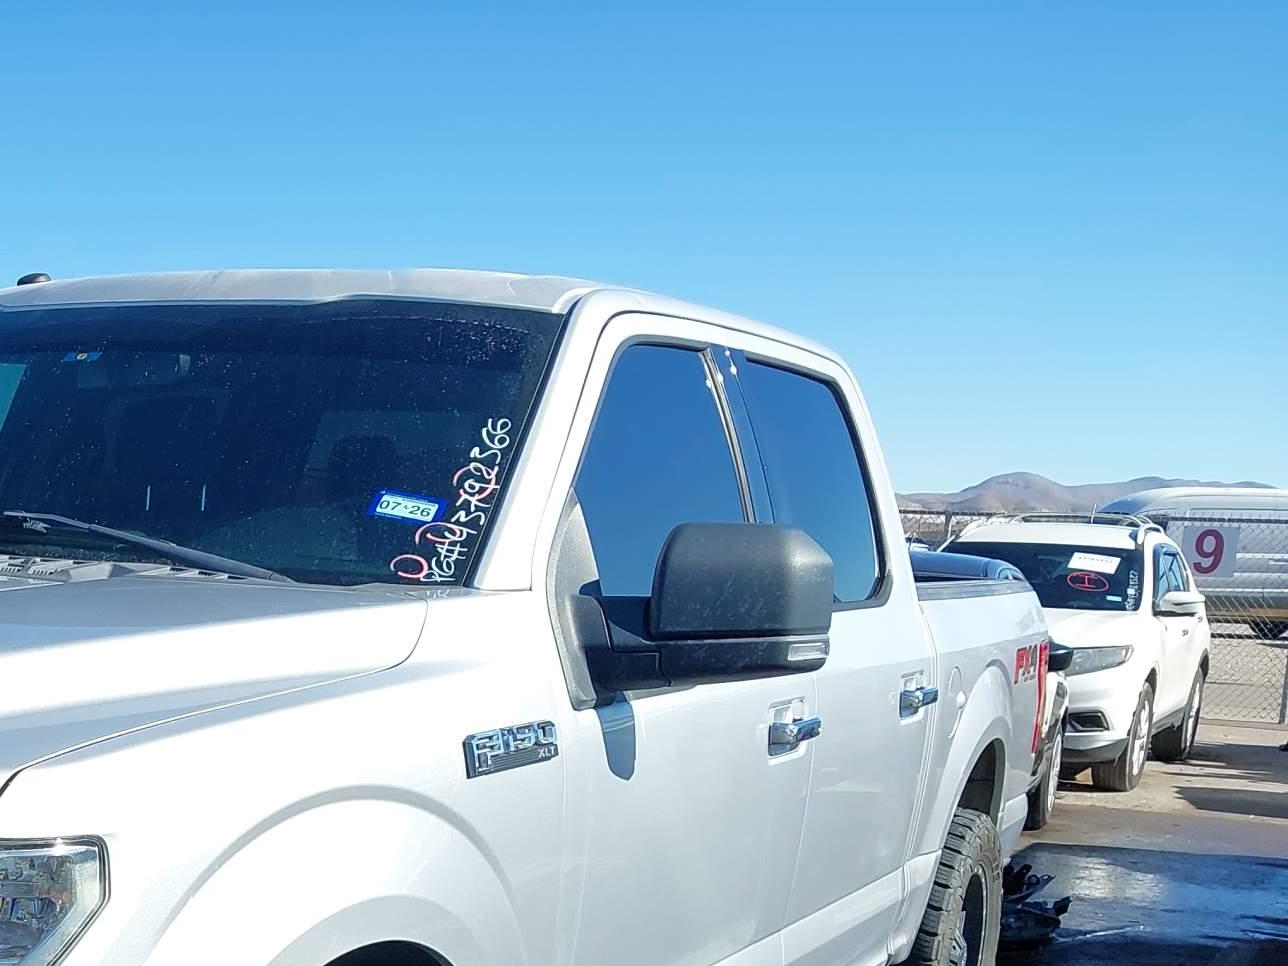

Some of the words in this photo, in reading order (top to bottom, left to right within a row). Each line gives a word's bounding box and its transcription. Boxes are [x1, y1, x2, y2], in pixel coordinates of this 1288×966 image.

[379, 500, 403, 511] 07
[408, 505, 432, 517] 26
[1193, 528, 1225, 575] 9
[538, 745, 556, 758] XLT
